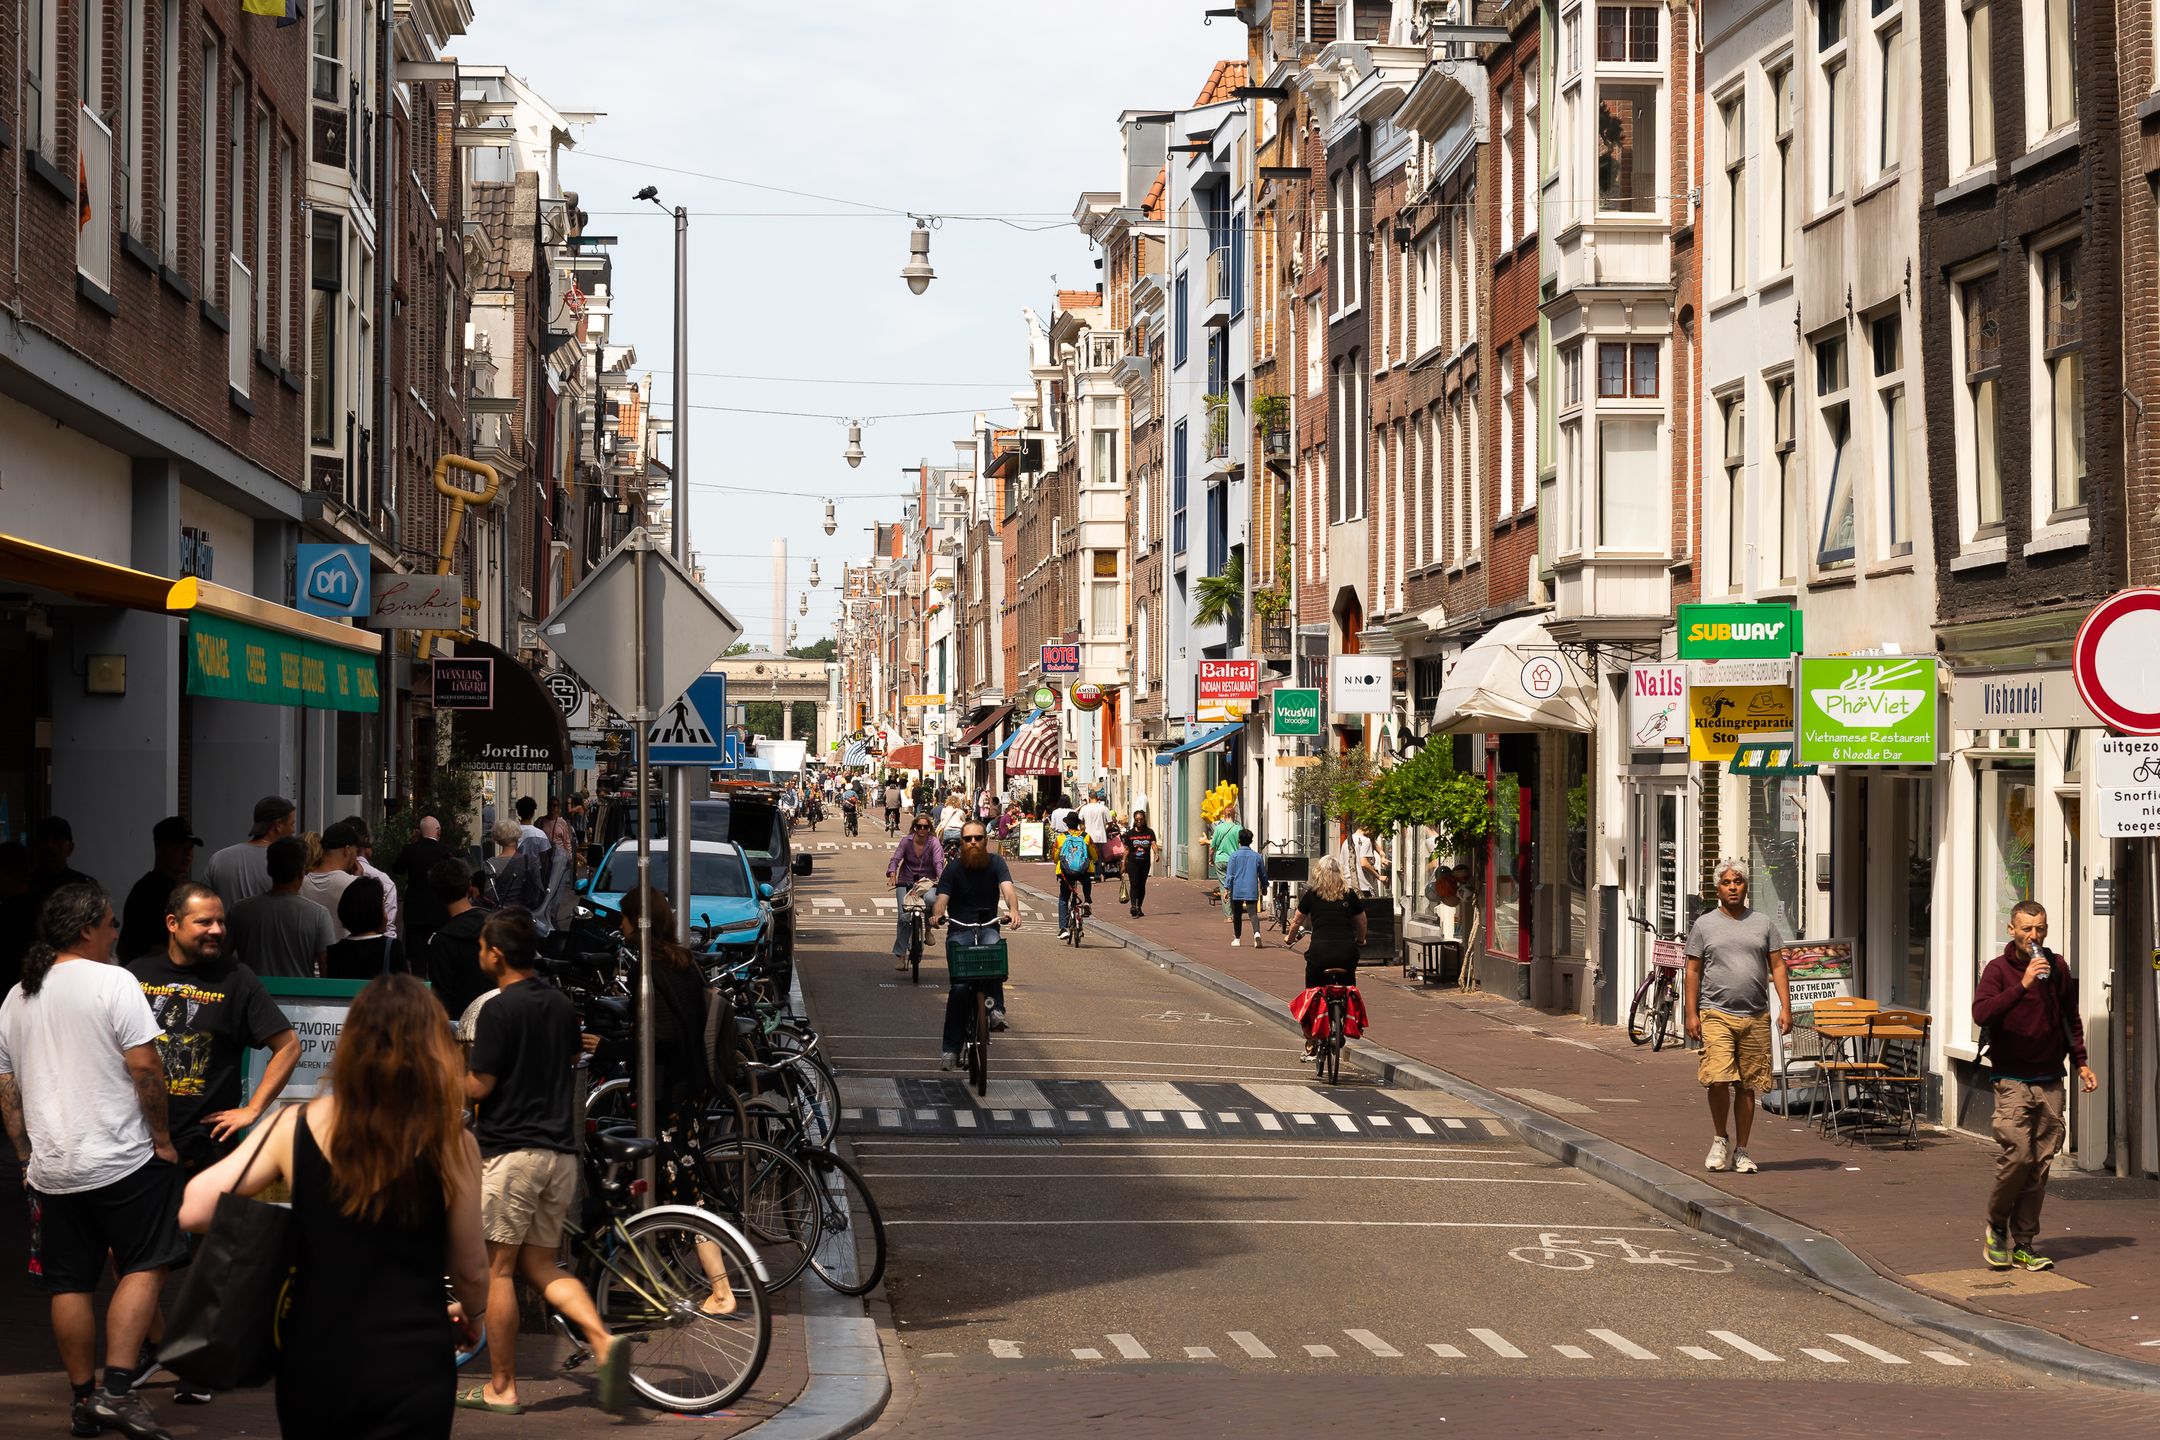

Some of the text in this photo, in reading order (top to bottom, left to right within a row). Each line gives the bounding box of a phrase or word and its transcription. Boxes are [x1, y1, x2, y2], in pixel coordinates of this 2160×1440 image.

[374, 581, 458, 616] kinki
[1687, 621, 1786, 642] SUBWAY
[196, 631, 230, 679] FROMAGE
[245, 643, 267, 685] CHEESE
[1043, 646, 1079, 664] HOTEL
[1201, 662, 1255, 681] Balraj
[1200, 681, 1256, 693] INDIAN RESTAURANT
[1635, 668, 1683, 696] Nails
[1036, 694, 1052, 703] SLA
[1867, 691, 1910, 714] Viet
[1984, 681, 2043, 714] Vishandel
[1277, 707, 1316, 718] VkusVill
[1284, 717, 1310, 726] broodjes
[1694, 716, 1794, 731] Kledingreparatie
[1712, 732, 1739, 743] Sto
[1805, 729, 1931, 743] Vietnamese Restaurant
[481, 743, 550, 758] Jordino
[1832, 746, 1903, 760] & Noodle Bar
[505, 763, 512, 771] &
[513, 763, 526, 771] ICE
[526, 763, 554, 771] CREAM
[2114, 790, 2160, 801] Snorfi
[139, 981, 225, 1005] Grave Digger
[1796, 984, 1805, 992] OF
[1807, 983, 1820, 991] THE
[1800, 990, 1837, 1000] EVERYDAY
[291, 1021, 346, 1036] FAVORIE
